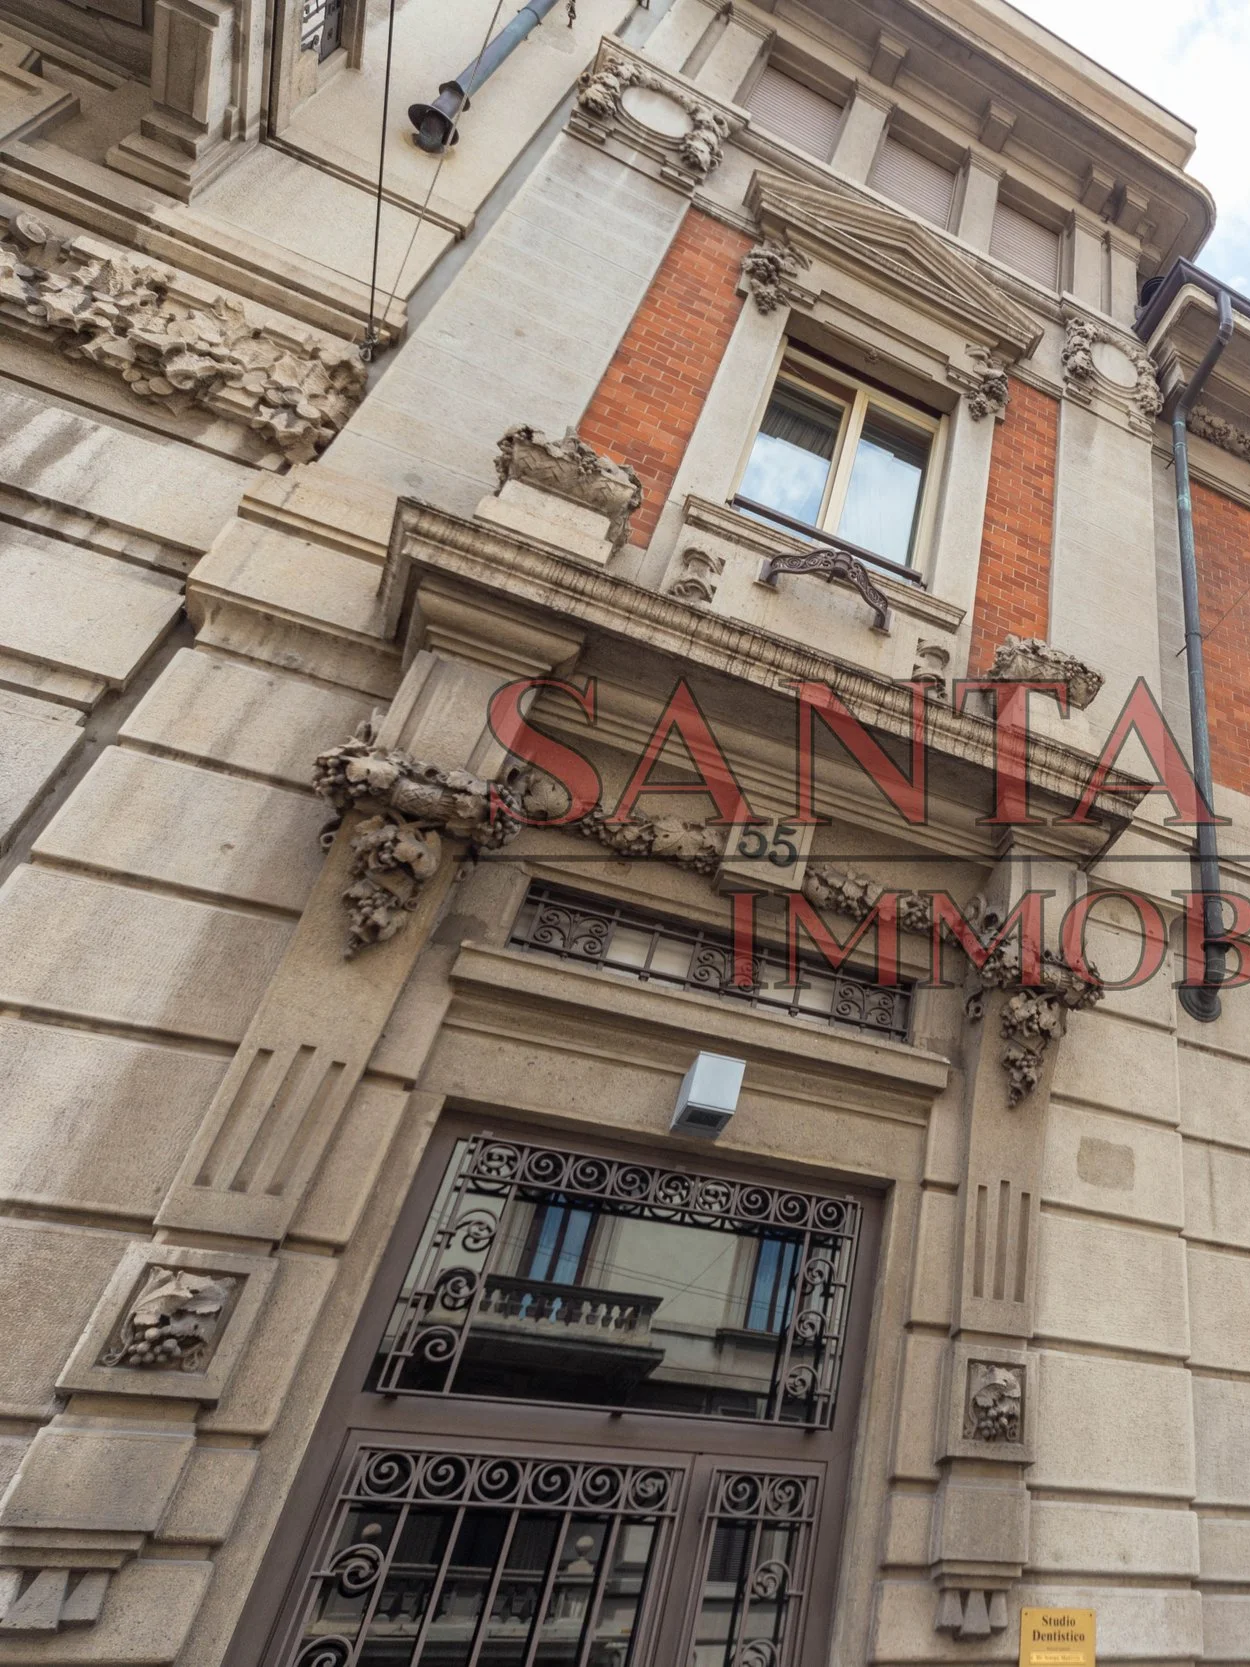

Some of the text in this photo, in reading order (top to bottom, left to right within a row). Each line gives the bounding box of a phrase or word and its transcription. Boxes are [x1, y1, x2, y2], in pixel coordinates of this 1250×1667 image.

[738, 823, 798, 867] 55
[1041, 1615, 1076, 1627] Studio
[1032, 1629, 1085, 1642] Dentistico
